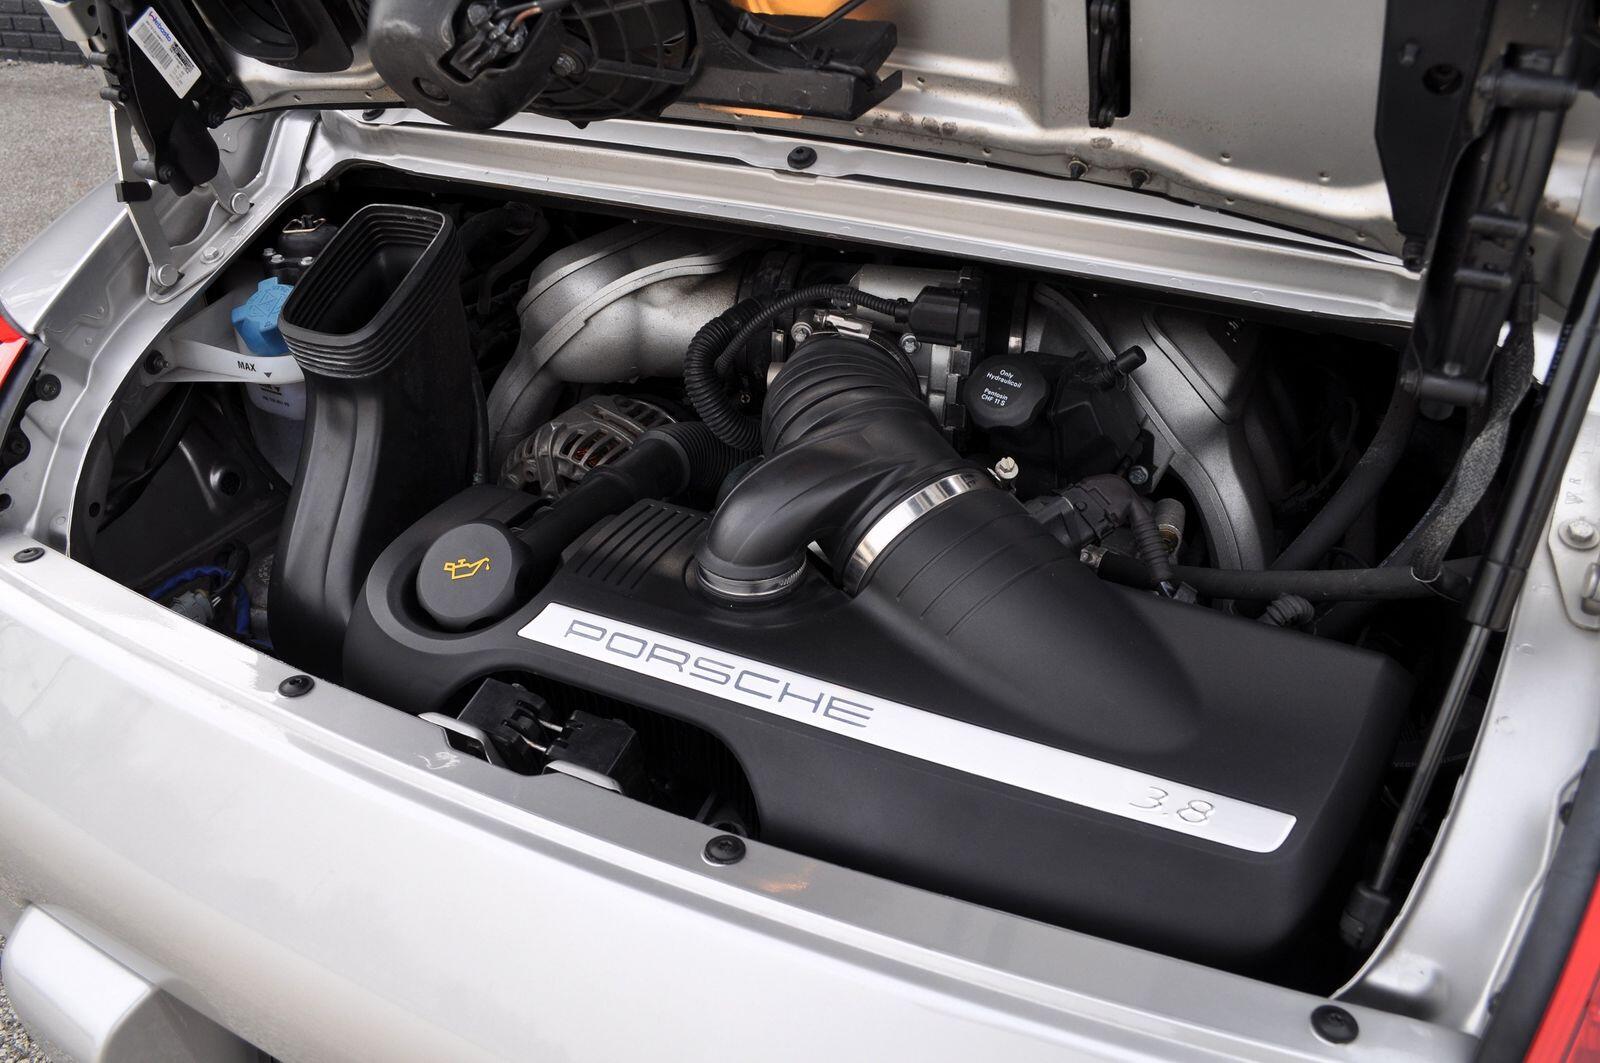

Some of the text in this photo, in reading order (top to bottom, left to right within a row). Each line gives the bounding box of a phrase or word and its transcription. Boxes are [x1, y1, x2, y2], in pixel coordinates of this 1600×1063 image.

[237, 360, 257, 373] MAX
[986, 372, 1023, 388] Hydraulicoil
[999, 369, 1014, 379] Only
[981, 393, 993, 402] CHF
[984, 387, 1008, 401] Pentosin
[563, 619, 875, 728] PORSCHE
[1128, 785, 1215, 823] 3.8
